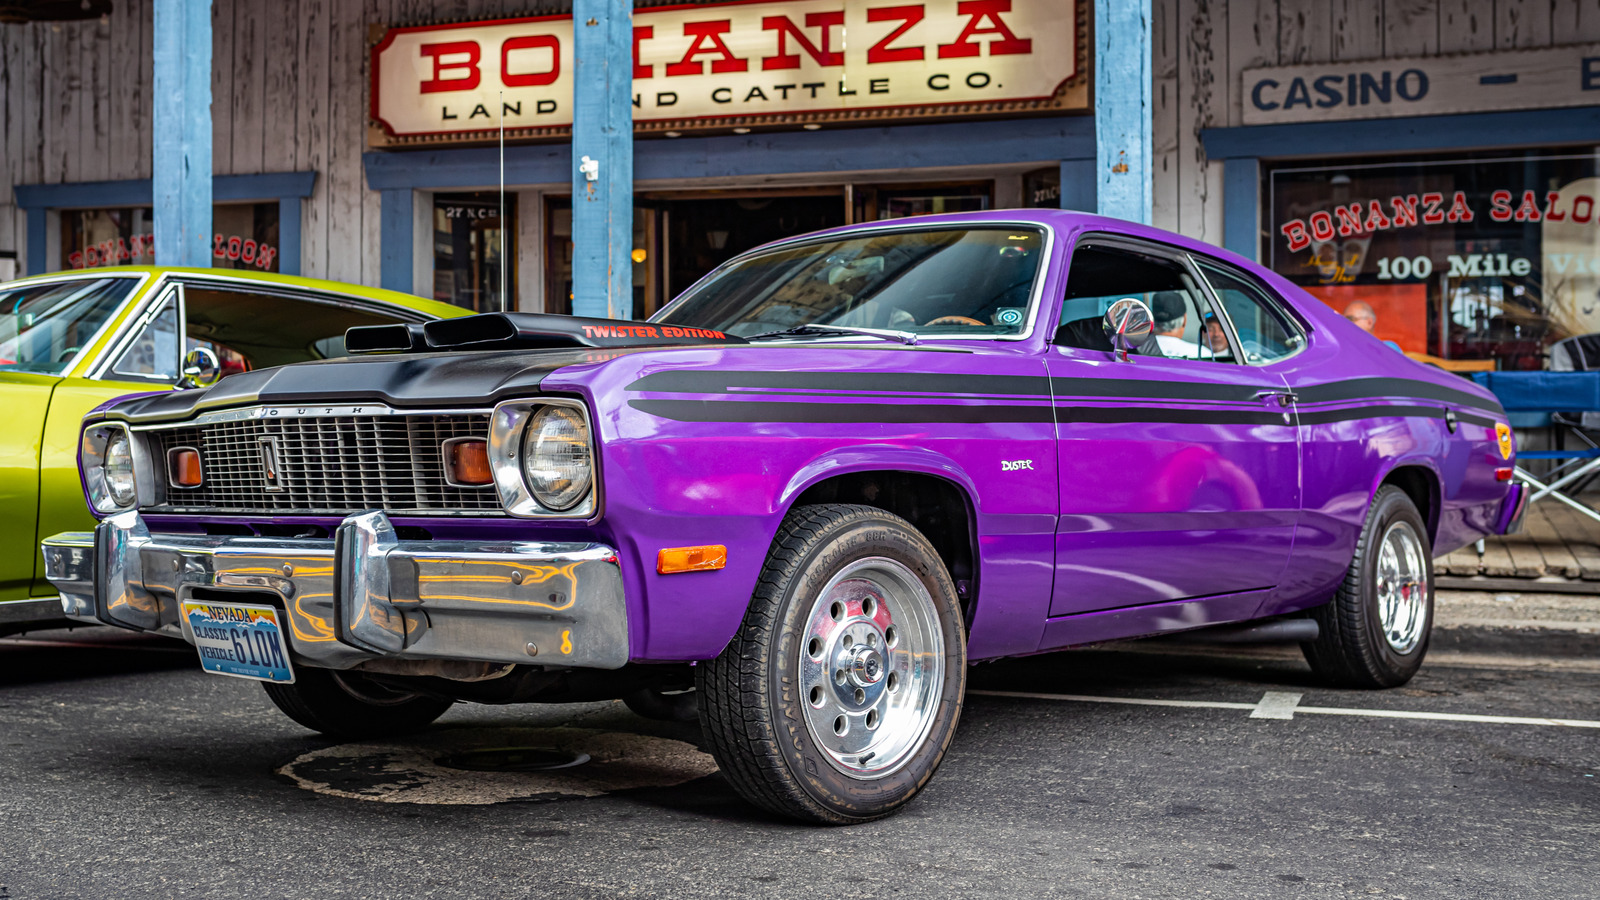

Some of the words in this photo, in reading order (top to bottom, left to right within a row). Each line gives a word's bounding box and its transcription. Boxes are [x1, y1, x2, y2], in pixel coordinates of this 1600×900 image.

[420, 0, 1033, 94] BOANZA
[442, 99, 557, 120] LAND
[711, 78, 890, 104] CATTLE
[927, 72, 1003, 91] CO.
[1252, 69, 1429, 110] CASINO
[446, 206, 463, 218] 27
[1281, 191, 1474, 252] BONANZA
[1490, 190, 1600, 223] SALO
[69, 233, 154, 269] BONANZ
[214, 233, 276, 270] LOON
[1377, 255, 1432, 279] 100
[1447, 253, 1531, 277] Mile
[582, 325, 660, 339] TWISTER
[661, 326, 726, 340] EDITION
[1001, 459, 1034, 471] DUSTER
[207, 605, 253, 623] NEVADA
[193, 625, 229, 641] CLASSIC
[230, 628, 286, 669] 610M
[199, 645, 235, 662] VEHICLE
